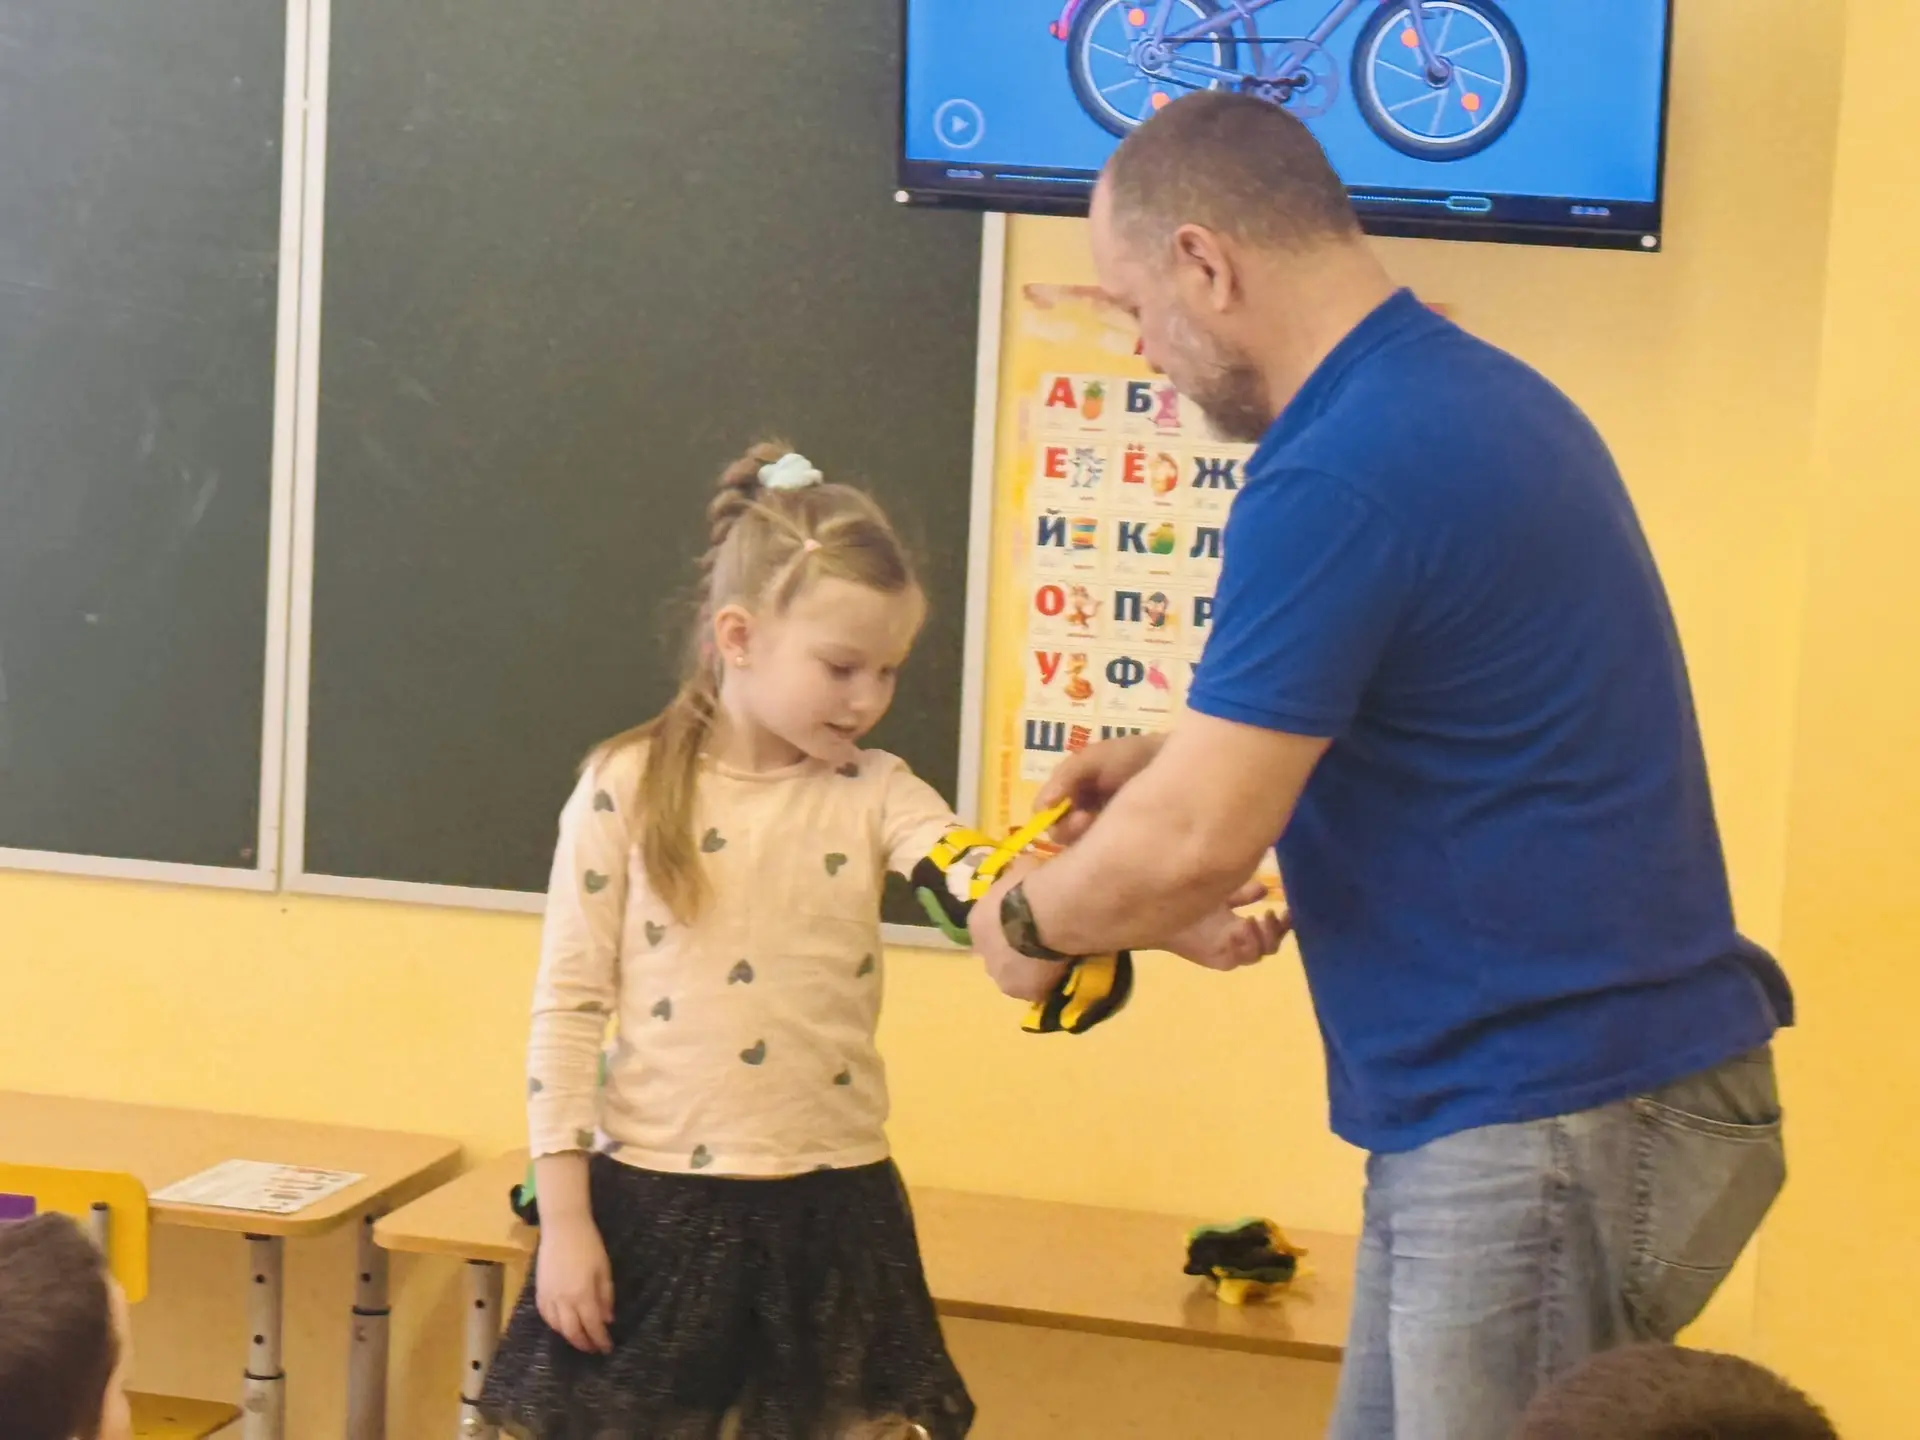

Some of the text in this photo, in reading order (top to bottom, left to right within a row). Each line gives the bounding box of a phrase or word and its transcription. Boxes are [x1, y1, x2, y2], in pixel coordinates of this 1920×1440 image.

[1045, 377, 1152, 413] А Б
[1044, 443, 1239, 489] Е Ё Ж
[1037, 508, 1220, 558] Й К Л
[1035, 585, 1065, 616] О
[1114, 591, 1142, 622] П
[1034, 651, 1144, 688] У Ф
[1024, 719, 1065, 752] Ш
